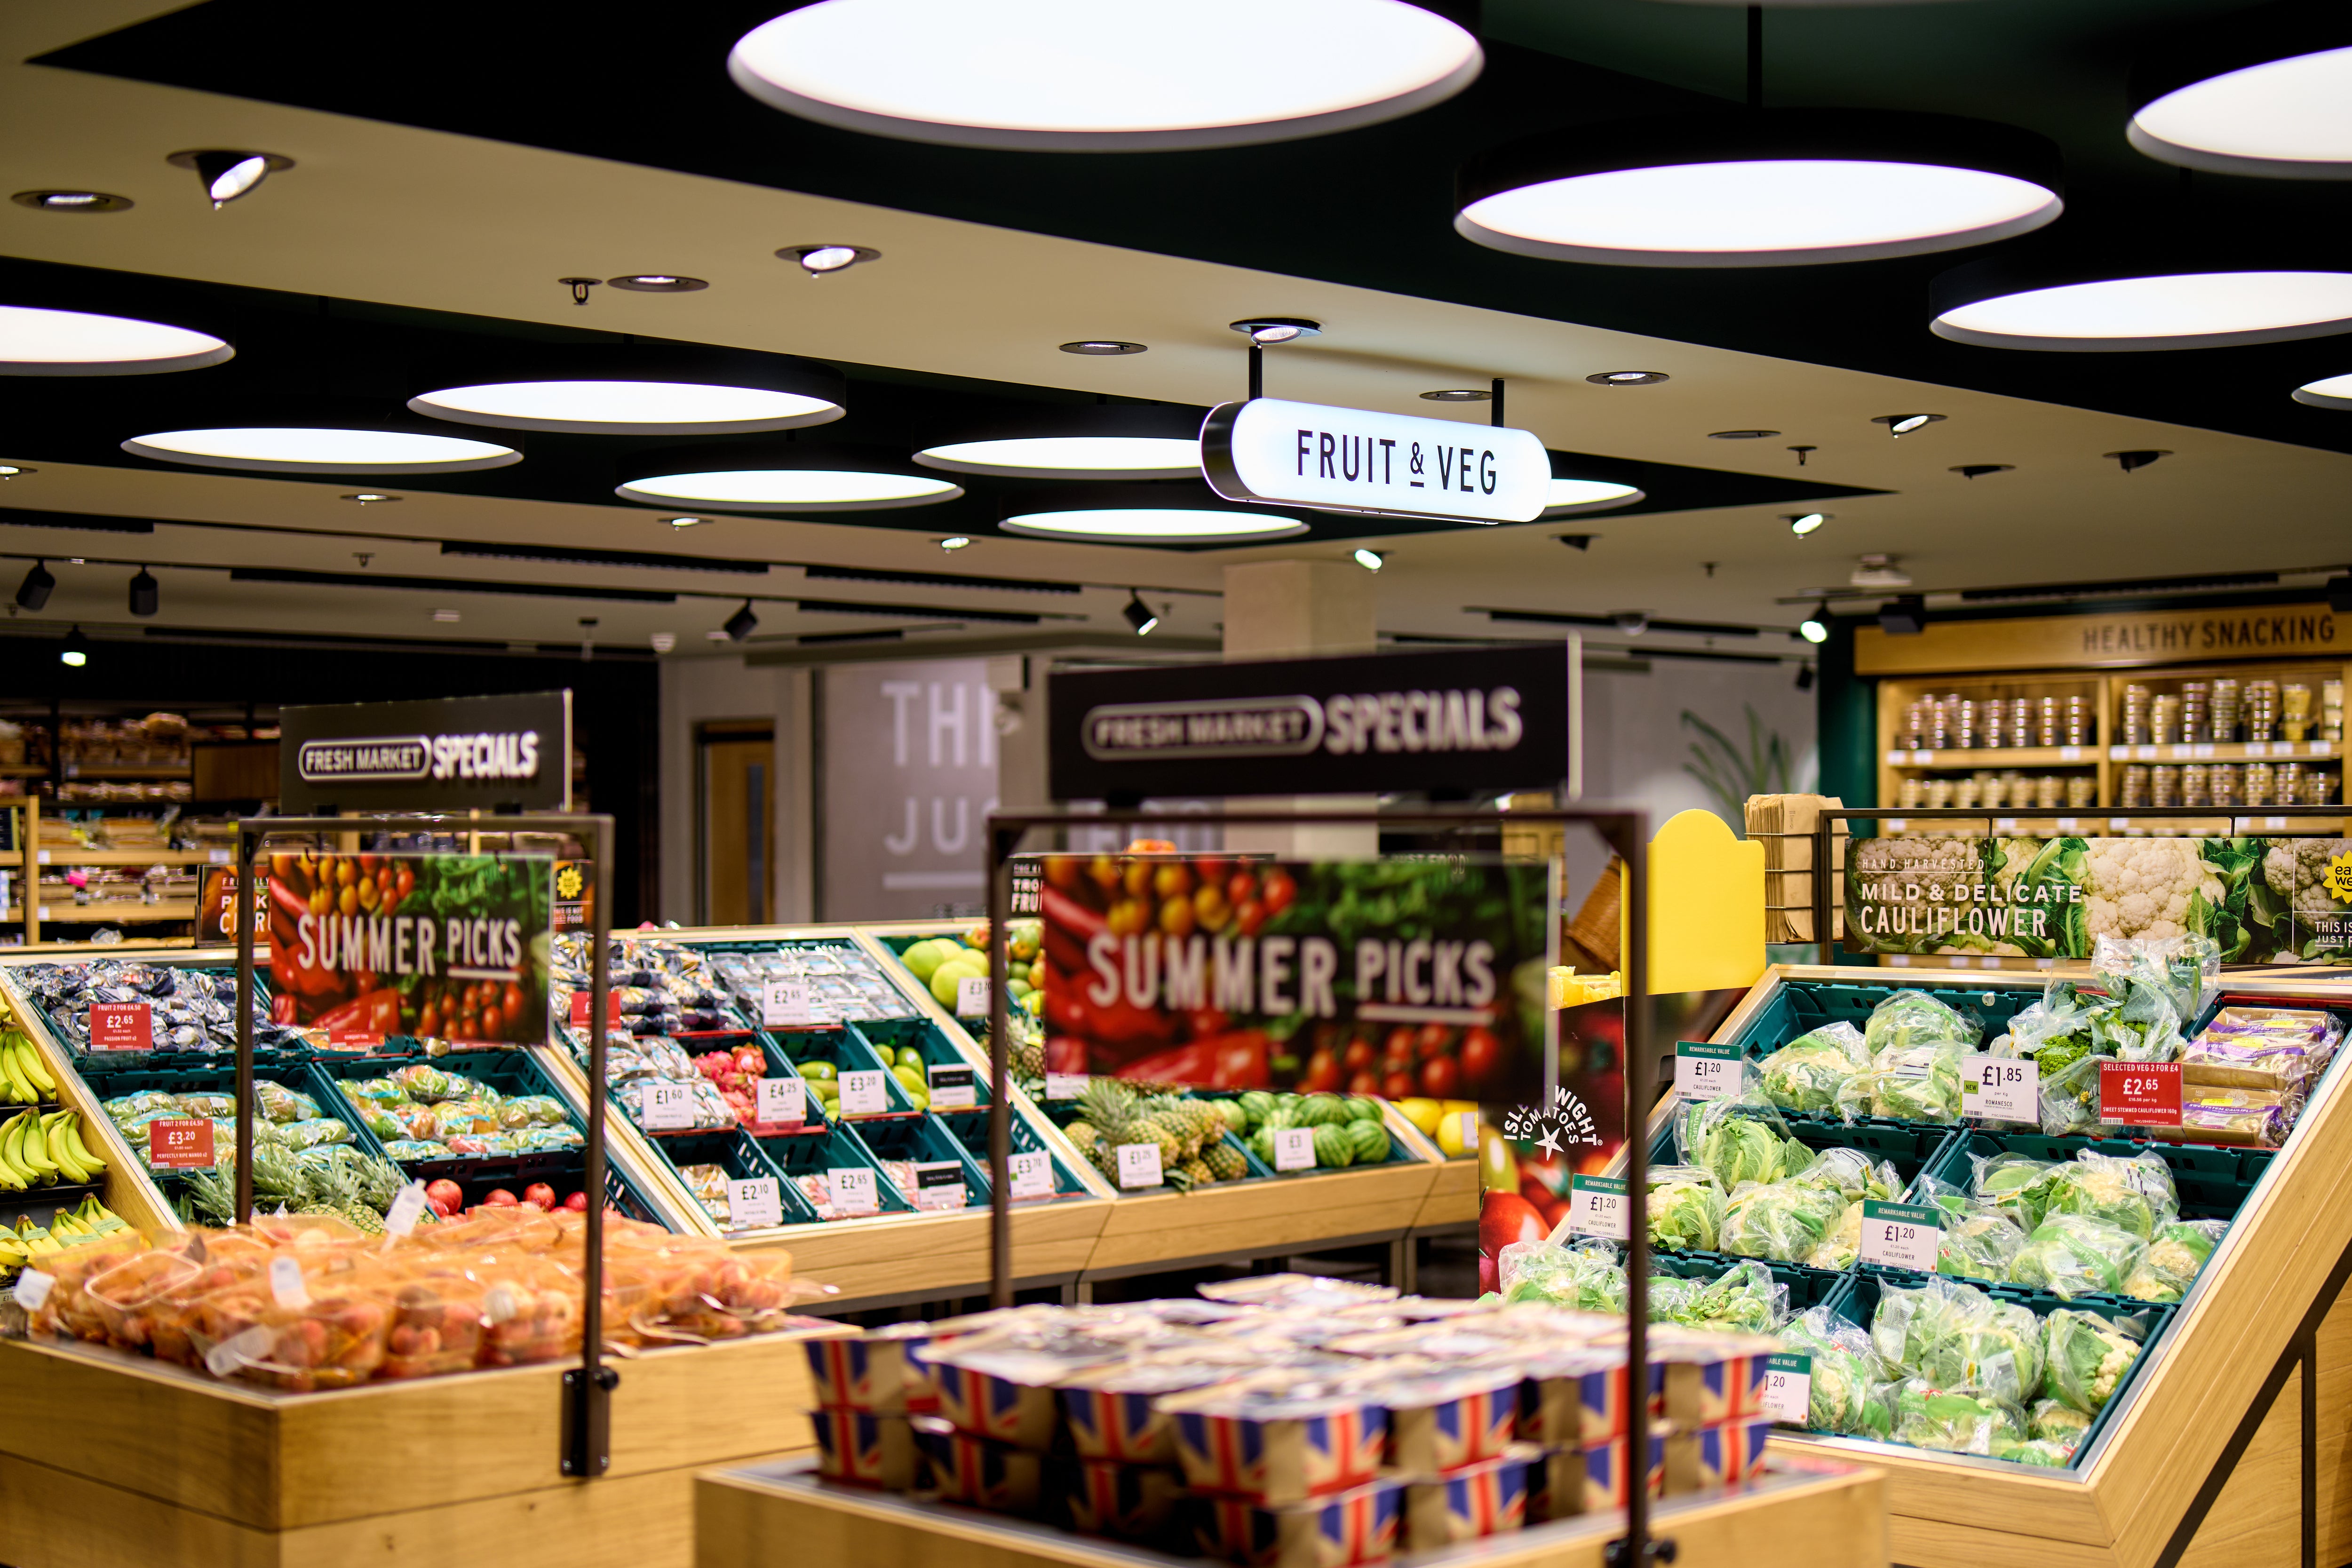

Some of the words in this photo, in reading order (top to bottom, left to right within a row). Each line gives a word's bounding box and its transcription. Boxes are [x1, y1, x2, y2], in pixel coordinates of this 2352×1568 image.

[1298, 429, 1396, 485] FRUIT
[1410, 441, 1424, 487] &
[1438, 445, 1497, 495] VEG
[2083, 621, 2194, 653] HEALTHY
[2202, 614, 2335, 648] SNACKING
[1324, 686, 1523, 754] SPECIALS
[1095, 716, 1182, 748] FRESH
[305, 749, 353, 772] FRESH
[356, 746, 423, 771] MARKET
[432, 731, 539, 779] SPECIALS
[1862, 859, 1896, 869] HAND
[1904, 859, 1985, 870] HARVESTED
[1861, 883, 1921, 901] MILD
[1929, 885, 1945, 901] &
[1955, 884, 2082, 904] DELICATE
[1860, 906, 2046, 937] CAULIFLOWER
[2315, 921, 2340, 932] THIS
[297, 913, 437, 977] SUMMER
[447, 918, 522, 968] PICKS
[1086, 932, 1338, 1019] SUMMER
[1355, 939, 1497, 1007] PICKS
[106, 1015, 134, 1028] £2.65
[1695, 1061, 1721, 1076] £1.20
[1982, 1065, 2022, 1087] £1.85
[2123, 1078, 2159, 1095] £2.65
[1520, 1106, 1580, 1145] TOMATOES
[168, 1131, 195, 1145] £3.20
[741, 1184, 769, 1201] £2.10
[1590, 1196, 1617, 1212] £1.20
[1588, 1219, 1617, 1229] CAULIFLOWER
[1884, 1225, 1915, 1242] £1.20
[1883, 1250, 1915, 1260] CAULIFLOWER
[1782, 1359, 1797, 1367] VALUE
